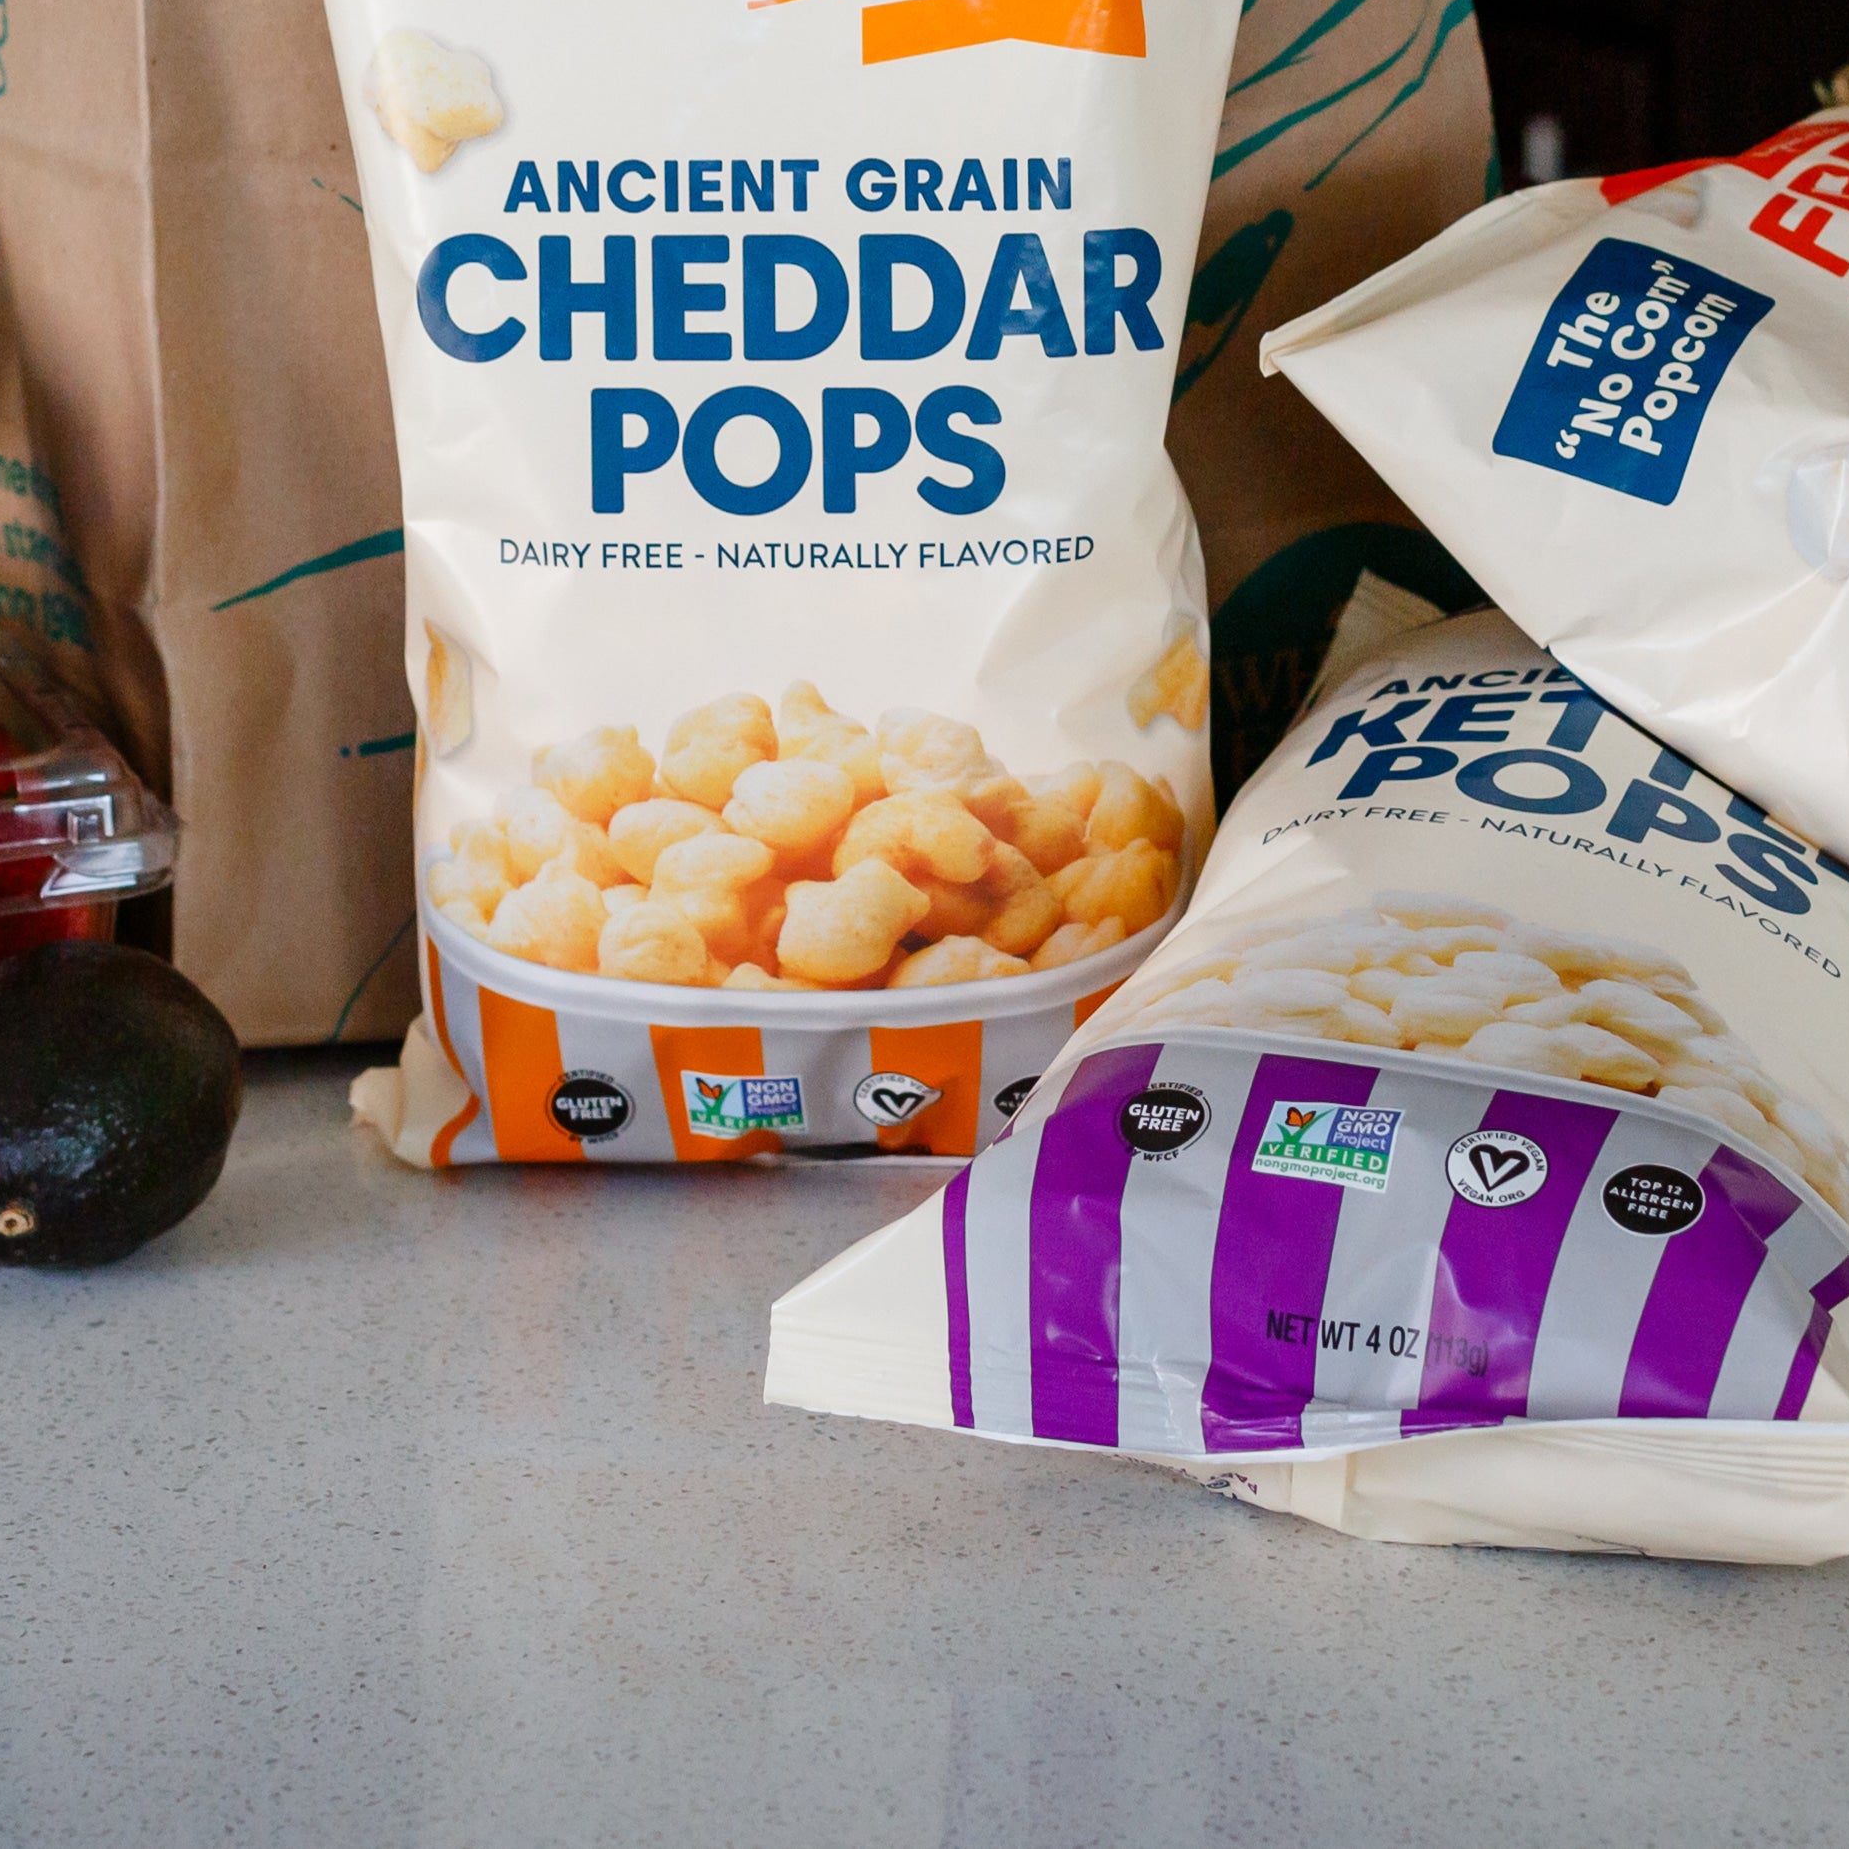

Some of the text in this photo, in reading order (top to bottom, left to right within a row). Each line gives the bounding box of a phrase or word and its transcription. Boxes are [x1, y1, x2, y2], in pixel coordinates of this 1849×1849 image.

[503, 156, 1073, 214] ANCIENT GRAIN
[415, 227, 1166, 364] CHEDDAR
[1547, 290, 1621, 370] The
[1618, 292, 1738, 457] Popcorn
[590, 384, 1008, 517] POPS
[499, 538, 591, 570] DAIRY
[601, 543, 684, 570] FREE
[716, 542, 910, 570] NATURALLY
[918, 535, 1095, 570] FLAVORED
[1366, 667, 1586, 702] ANCIE
[1336, 746, 1820, 917] POPS
[1261, 805, 1359, 846] DAIRY
[1363, 805, 1451, 825] FREE
[1480, 816, 1674, 878] NATURALLY
[1680, 874, 1843, 980] FLAVORED
[746, 1080, 796, 1094] NON
[746, 1092, 799, 1107] GMO
[1142, 1081, 1204, 1098] CERTIFIED
[555, 1096, 624, 1110] GLUTEN
[569, 1106, 613, 1121] FREE
[1128, 1102, 1200, 1122] GLUTEN
[696, 1111, 800, 1129] VERIFIED
[1137, 1117, 1184, 1132] FREE
[1335, 1121, 1391, 1137] GMO
[1340, 1109, 1395, 1124] NON
[1332, 1131, 1388, 1151] Project
[1454, 1131, 1546, 1173] CERTIFIED VEGAN
[1143, 1150, 1181, 1163] WFCF
[1267, 1143, 1385, 1172] VERIFIED
[1254, 1156, 1386, 1191] nongmoproject.org
[1629, 1177, 1684, 1196] TOP 12
[1456, 1178, 1527, 1205] VEGAN.ORG
[1608, 1186, 1695, 1212] ALLERGEN
[1626, 1202, 1670, 1221] FREE
[1266, 1308, 1317, 1345] NET
[1320, 1319, 1362, 1353] WT
[1365, 1324, 1382, 1354] 4
[1388, 1325, 1421, 1358] OZ
